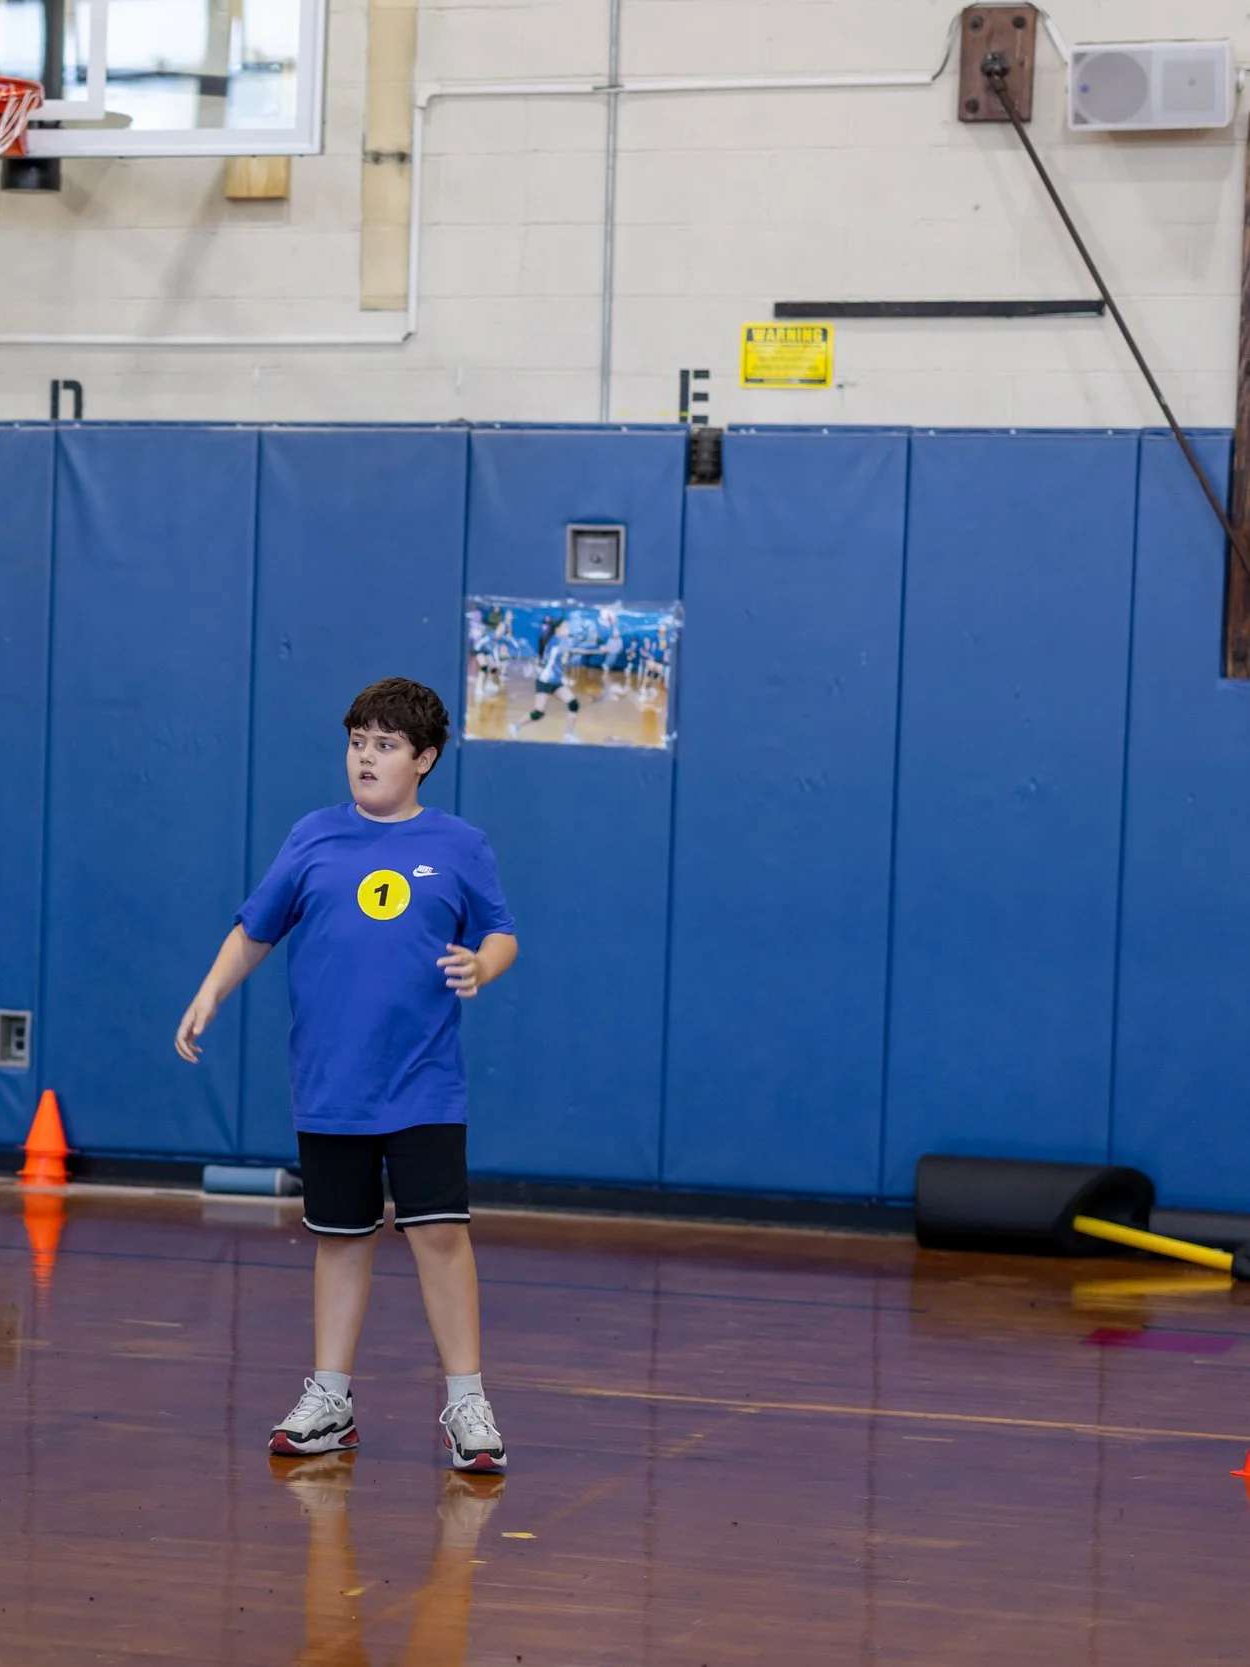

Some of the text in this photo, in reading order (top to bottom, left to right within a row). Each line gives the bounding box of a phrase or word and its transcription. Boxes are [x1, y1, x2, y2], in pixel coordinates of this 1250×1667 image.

[752, 327, 823, 343] WARNING
[679, 369, 710, 424] E
[373, 883, 390, 907] 1
